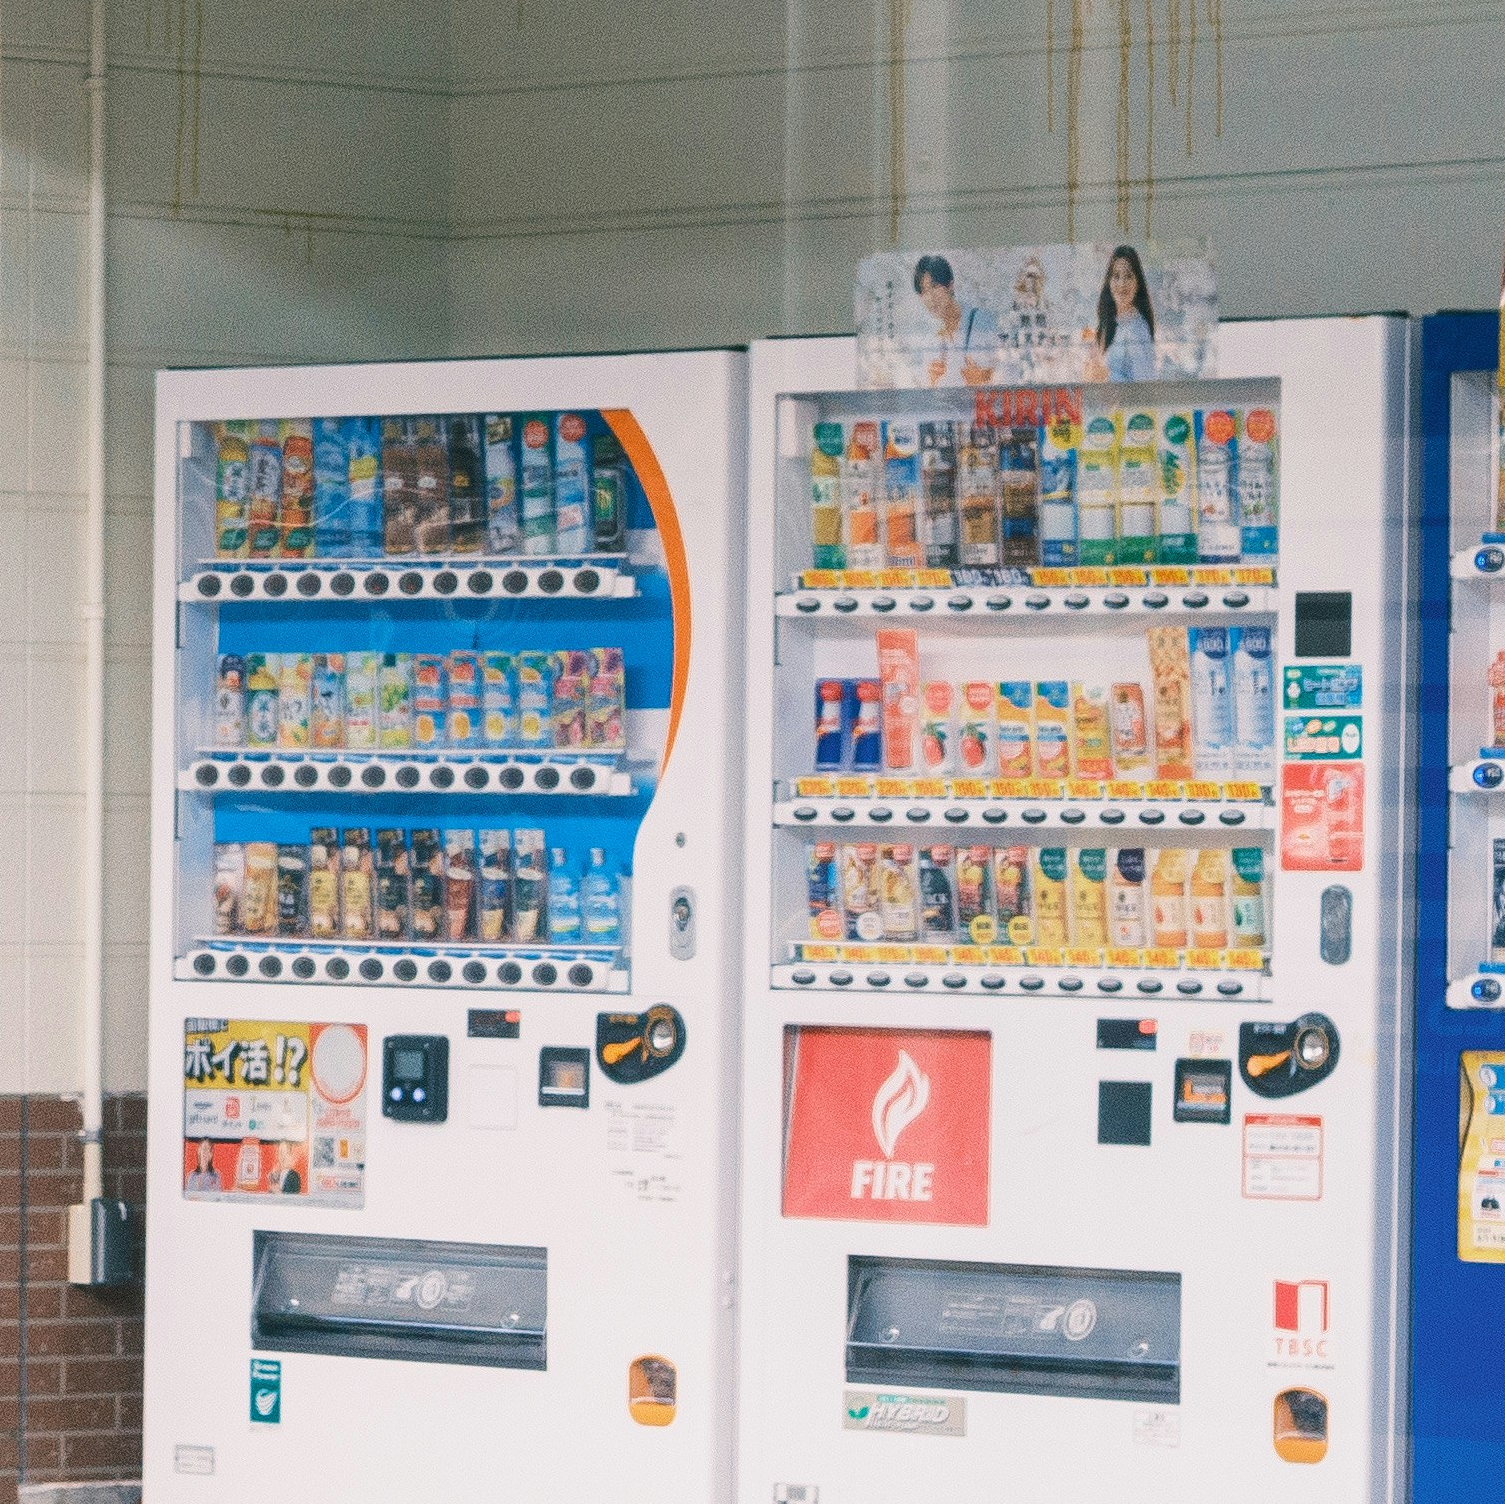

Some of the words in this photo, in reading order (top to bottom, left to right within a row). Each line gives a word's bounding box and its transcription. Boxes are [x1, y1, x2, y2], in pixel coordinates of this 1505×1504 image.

[974, 387, 1084, 429] KIRIN
[849, 1160, 935, 1203] FIRE
[1274, 1338, 1328, 1358] TBSC
